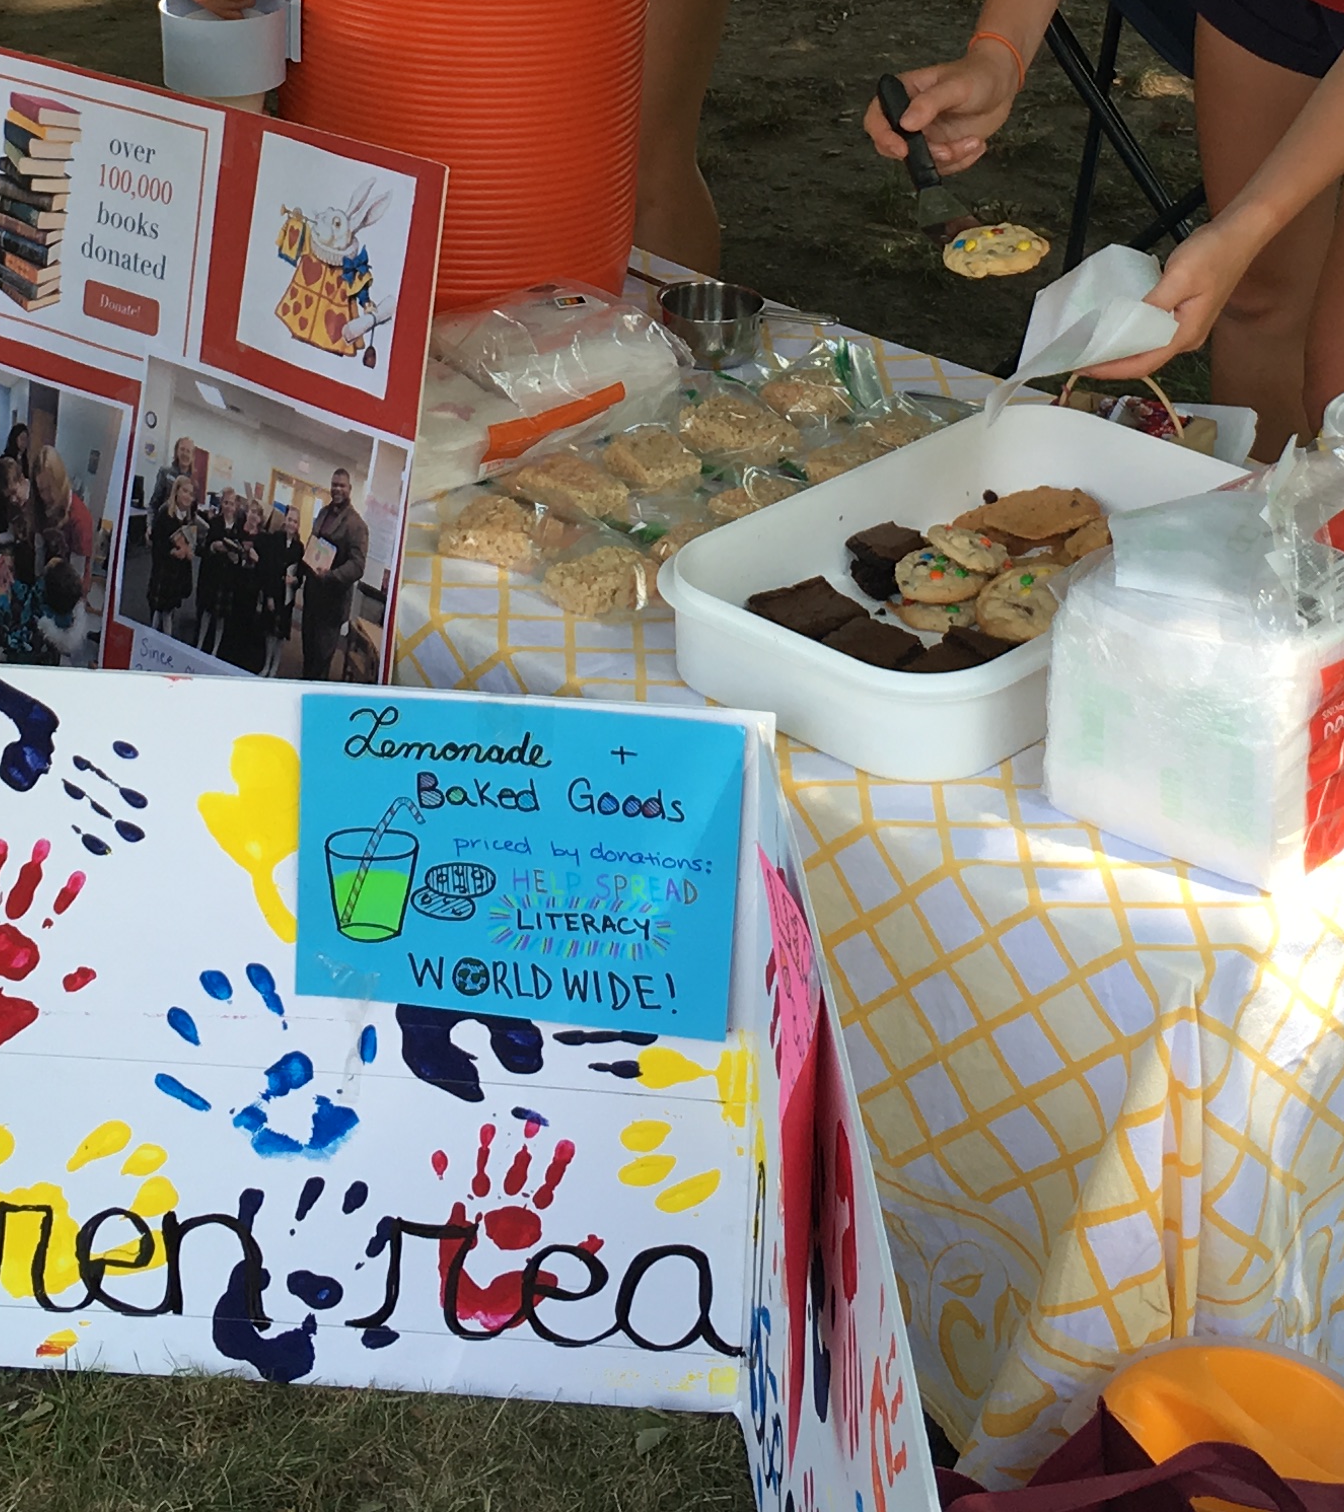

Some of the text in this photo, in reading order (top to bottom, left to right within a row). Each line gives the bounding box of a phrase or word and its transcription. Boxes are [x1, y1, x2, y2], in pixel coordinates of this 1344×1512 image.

[109, 138, 156, 164] over
[98, 163, 174, 205] 100,000
[96, 201, 160, 240] books
[80, 233, 167, 281] donated
[139, 637, 175, 668] Since
[344, 706, 552, 769] Lemonade
[416, 771, 686, 824] Baked Goods
[453, 835, 713, 875] priced by donations:
[512, 867, 699, 905] HELP SPREAD
[516, 908, 651, 941] LITERACY
